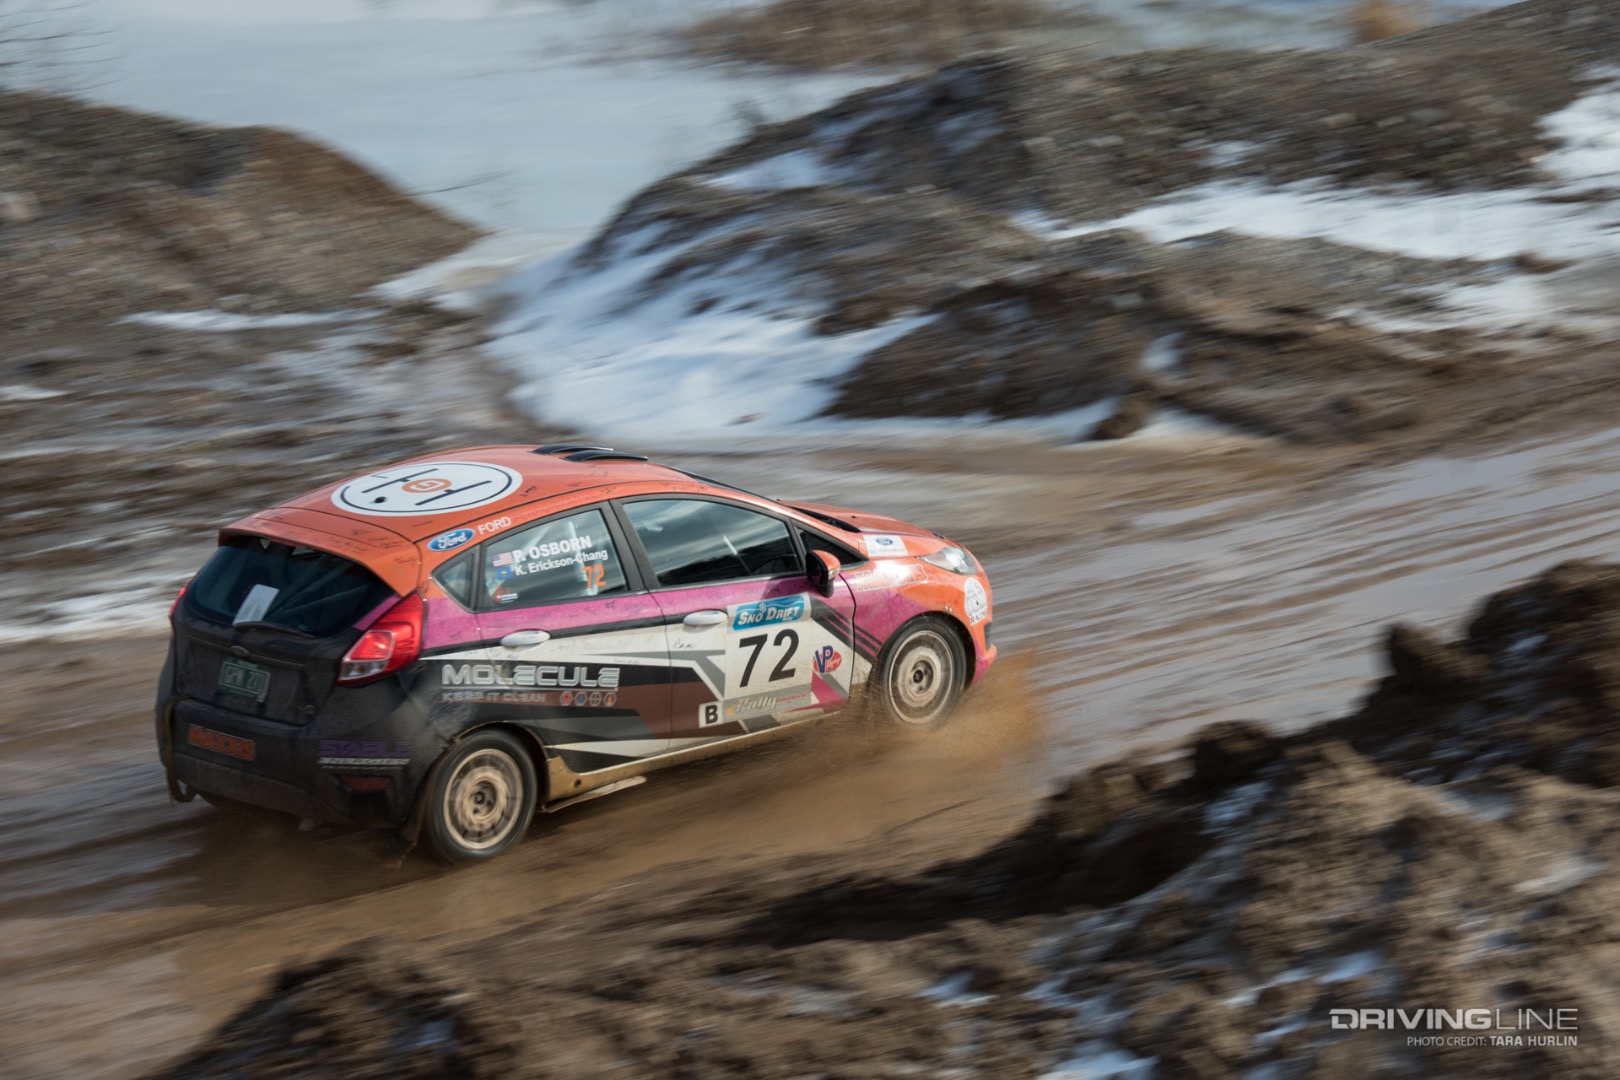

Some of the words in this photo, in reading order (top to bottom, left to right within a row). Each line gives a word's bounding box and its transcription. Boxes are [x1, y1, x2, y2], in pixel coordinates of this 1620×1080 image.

[477, 516, 512, 535] FORD
[512, 548, 527, 563] P.
[529, 535, 592, 559] OSBORN
[514, 564, 527, 576] K.
[528, 549, 608, 573] Erickson-Chang
[582, 563, 607, 589] 72
[738, 628, 800, 689] 72
[811, 643, 834, 673] VP
[441, 663, 621, 688] MOLECULE
[705, 705, 718, 725] B
